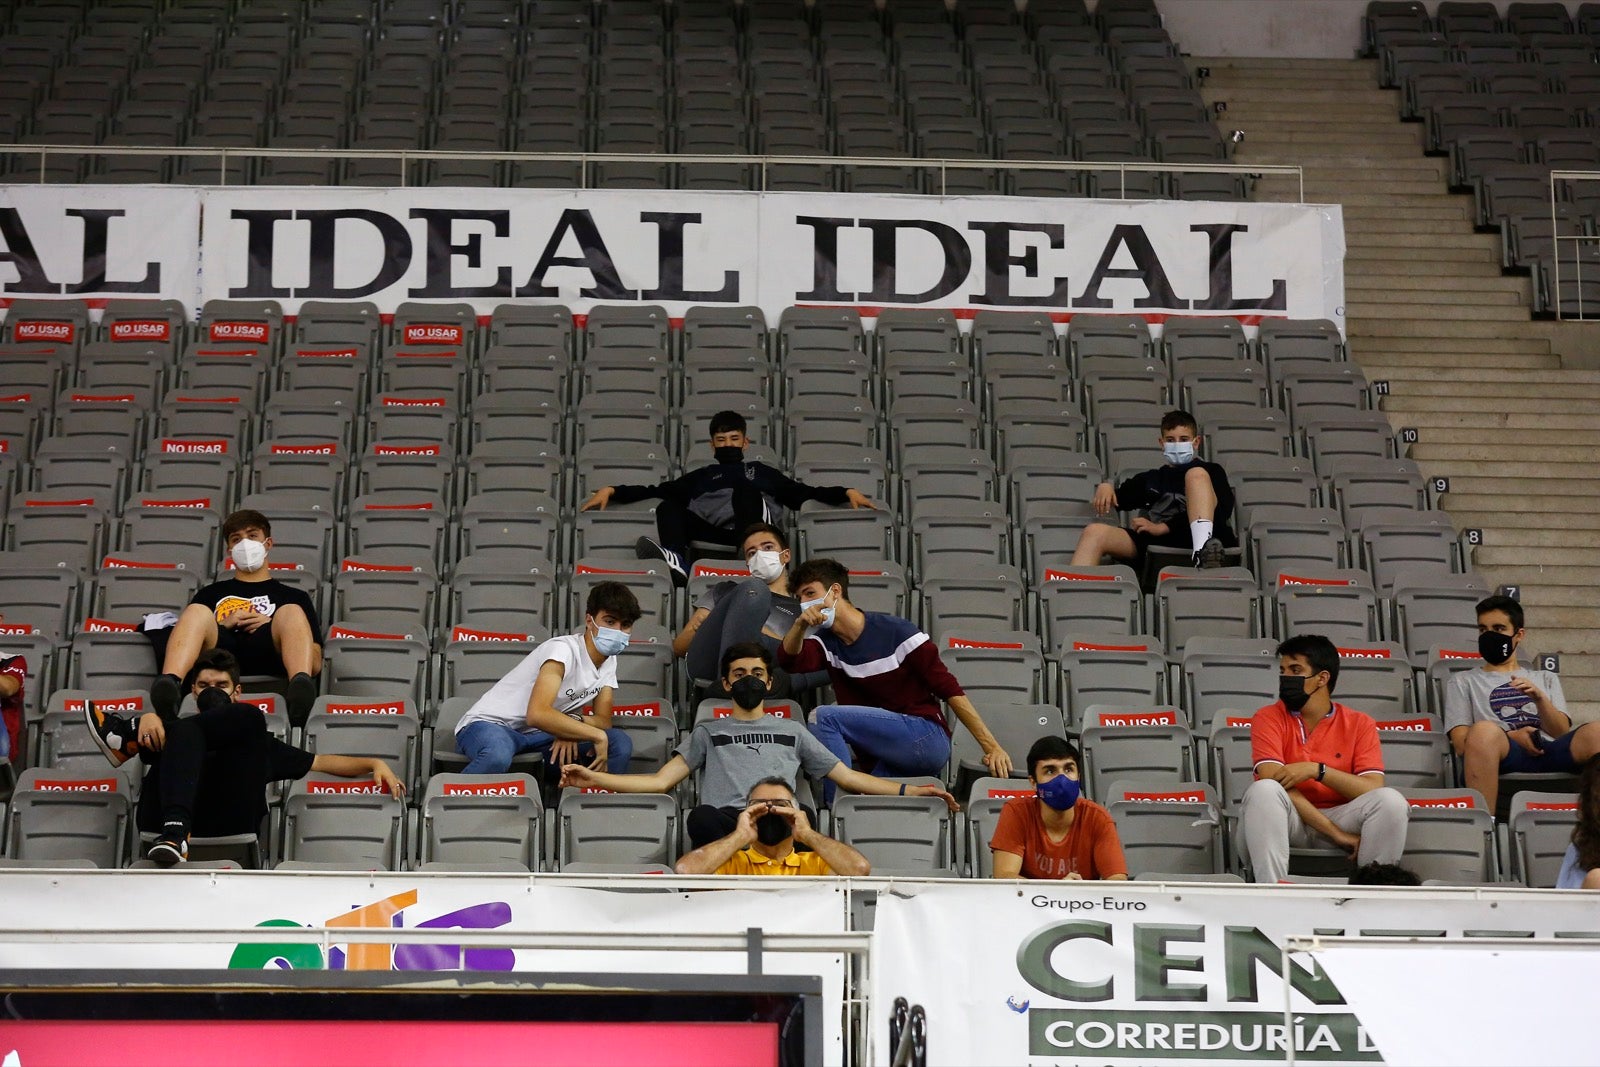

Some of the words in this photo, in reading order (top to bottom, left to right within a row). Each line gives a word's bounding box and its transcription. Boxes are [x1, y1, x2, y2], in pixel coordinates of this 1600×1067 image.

[227, 208, 740, 304] IDEAL
[795, 214, 1288, 311] IDEAL
[19, 325, 35, 334] NO
[38, 325, 69, 335] USAR
[114, 324, 130, 333] NO
[133, 325, 165, 334] USAR
[214, 325, 231, 335] NO
[233, 325, 264, 336] USAR
[408, 328, 424, 337] NO
[428, 328, 458, 338] USAR
[1376, 382, 1388, 394] 11
[1404, 430, 1416, 442] 10
[166, 444, 185, 453] NO
[187, 444, 222, 454] USAR
[1436, 479, 1446, 491] 9
[1469, 530, 1479, 543] 8
[1506, 587, 1516, 598] 7
[1545, 657, 1556, 670] 6
[734, 733, 773, 745] PUMA
[1035, 852, 1054, 875] YOU
[1058, 857, 1079, 875] ARE
[1031, 895, 1147, 913] Grupo-Euro
[1044, 1016, 1342, 1053] CORREDURÍA
